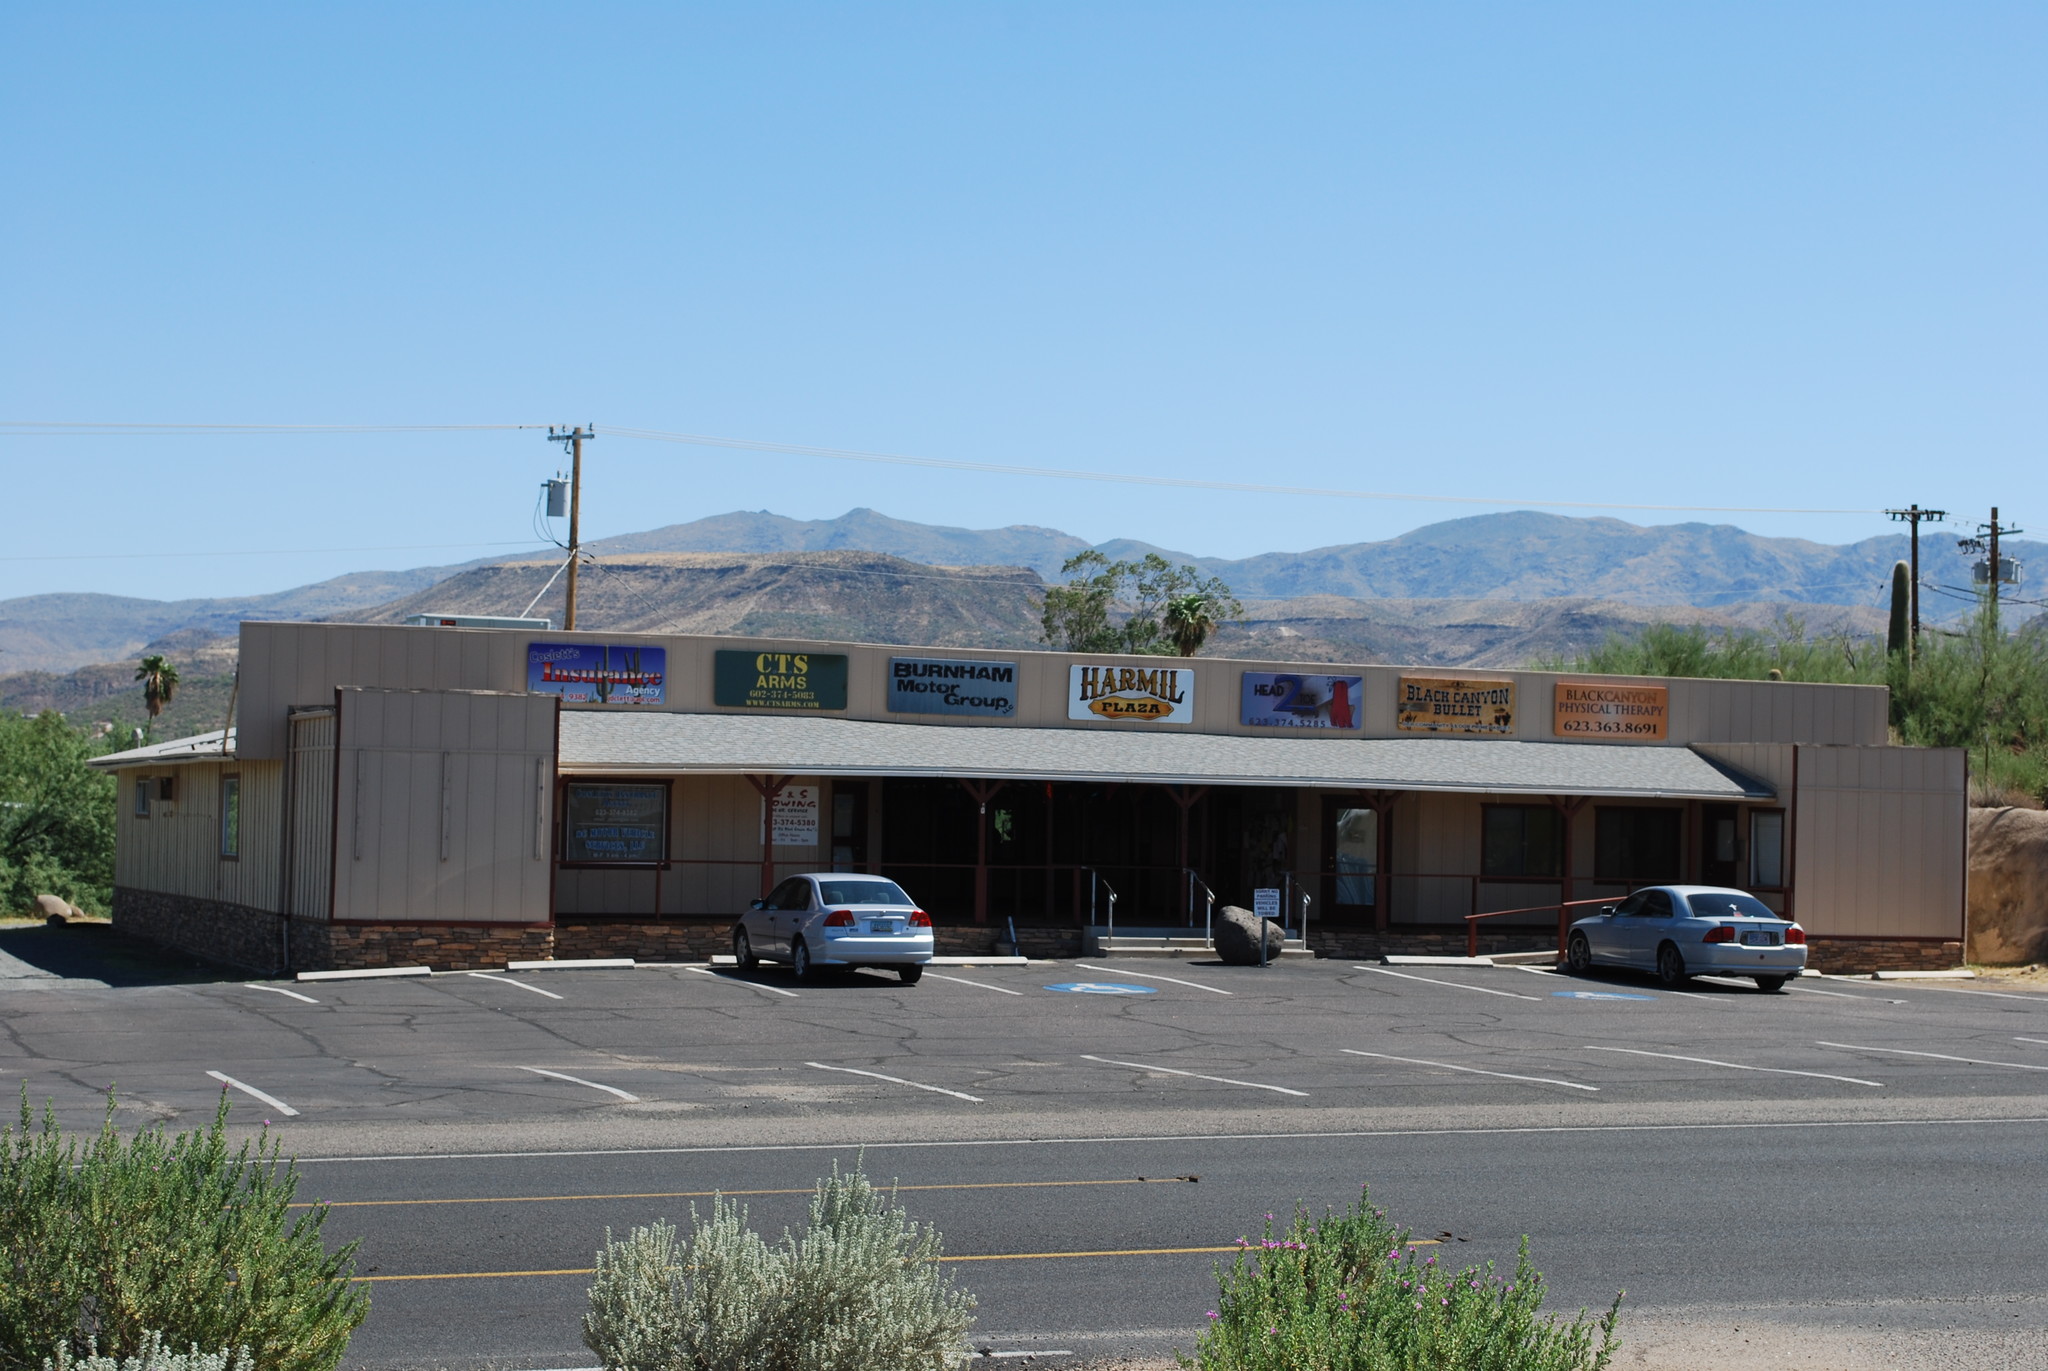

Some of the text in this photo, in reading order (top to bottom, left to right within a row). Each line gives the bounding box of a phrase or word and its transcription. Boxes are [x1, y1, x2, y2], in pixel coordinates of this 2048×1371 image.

[530, 648, 580, 662] Coslett's
[756, 653, 808, 674] CTS
[541, 662, 663, 685] Insurance
[893, 662, 1013, 683] BURNHAM
[756, 675, 807, 689] ARMS
[897, 679, 960, 695] Motor
[1080, 667, 1185, 704] HARMIL
[568, 693, 587, 701] 9382
[626, 685, 660, 695] Agency
[749, 690, 814, 699] 602-374-5083
[1254, 684, 1284, 697] HEAD
[1273, 674, 1315, 712] 2
[1406, 684, 1509, 705] BLACK CANYON
[746, 699, 819, 708] WWW.CTSARMS.COM
[943, 693, 1009, 710] Group
[1102, 702, 1160, 713] PLAZA
[1002, 704, 1014, 714] LLC
[1433, 703, 1482, 717] BULLET
[1559, 702, 1664, 717] PHYSICAL THERAPY
[1249, 717, 1326, 728] 623.374.5285
[1564, 720, 1657, 734] 623.363.8691
[800, 789, 808, 799] S
[772, 800, 816, 808] OWING
